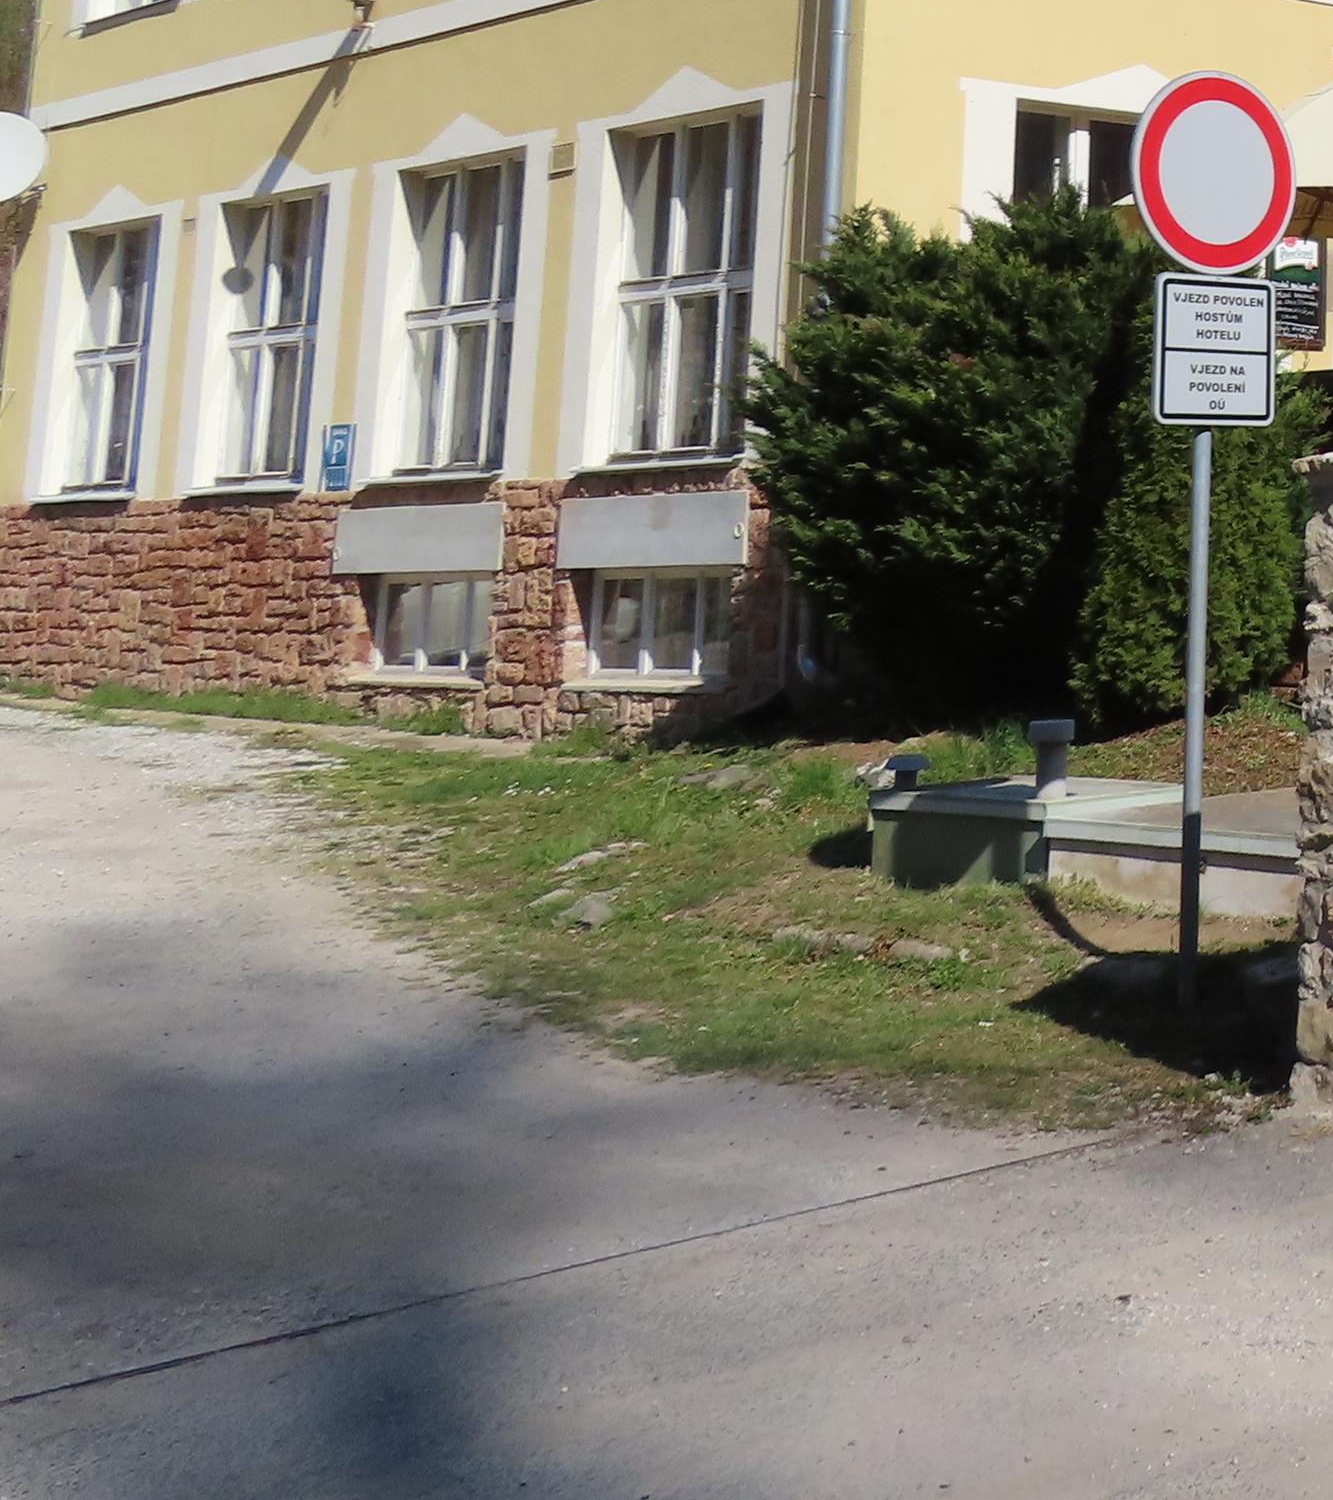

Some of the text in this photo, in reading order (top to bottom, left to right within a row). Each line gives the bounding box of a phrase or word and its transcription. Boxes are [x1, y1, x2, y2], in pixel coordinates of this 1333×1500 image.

[1173, 292, 1264, 307] VJEZD POVOLEN
[1196, 329, 1241, 341] HOTELU
[1190, 364, 1245, 376] VJEZD NA
